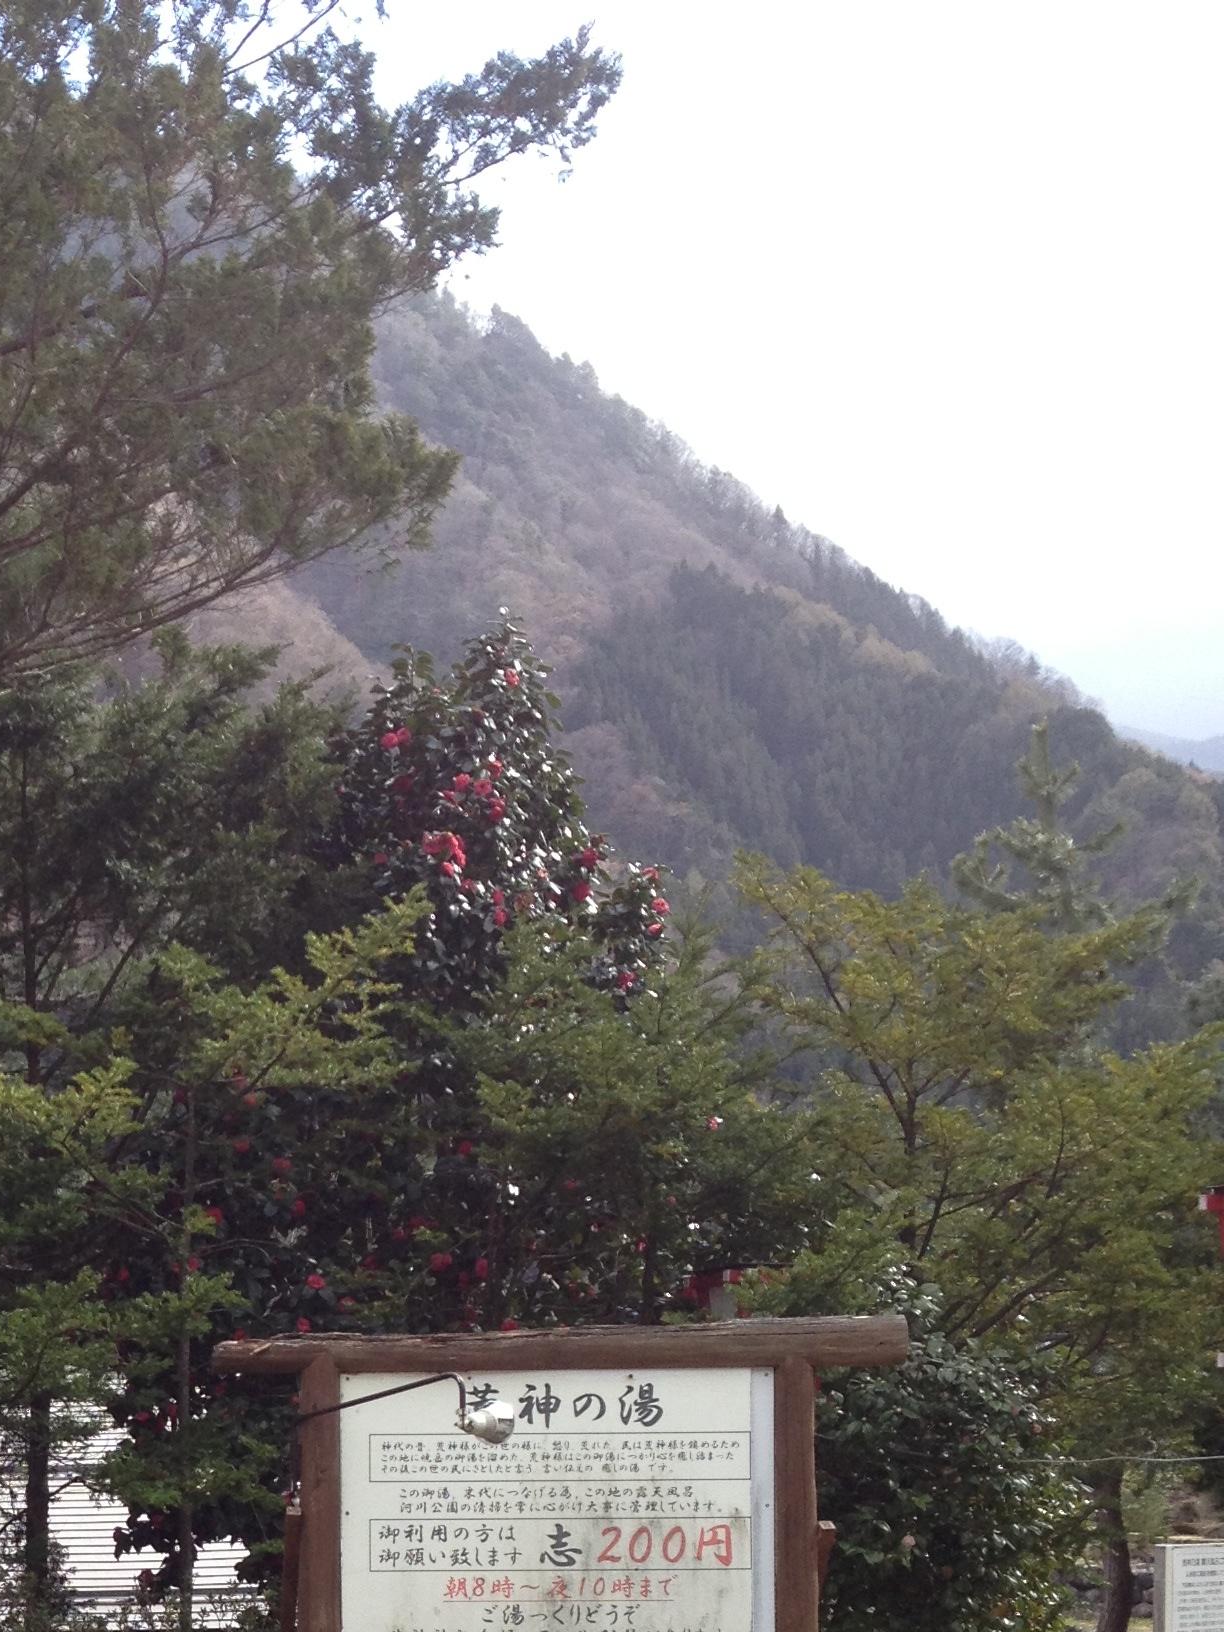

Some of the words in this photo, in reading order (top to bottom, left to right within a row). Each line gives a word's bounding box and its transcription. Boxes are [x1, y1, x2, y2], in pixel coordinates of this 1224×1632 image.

[378, 1523, 515, 1543] 御利用の方は
[539, 1522, 582, 1567] 志
[596, 1523, 733, 1566] 200円
[378, 1545, 522, 1567] 御願い致します
[481, 1604, 641, 1626] ご湯っくりどうぞ
